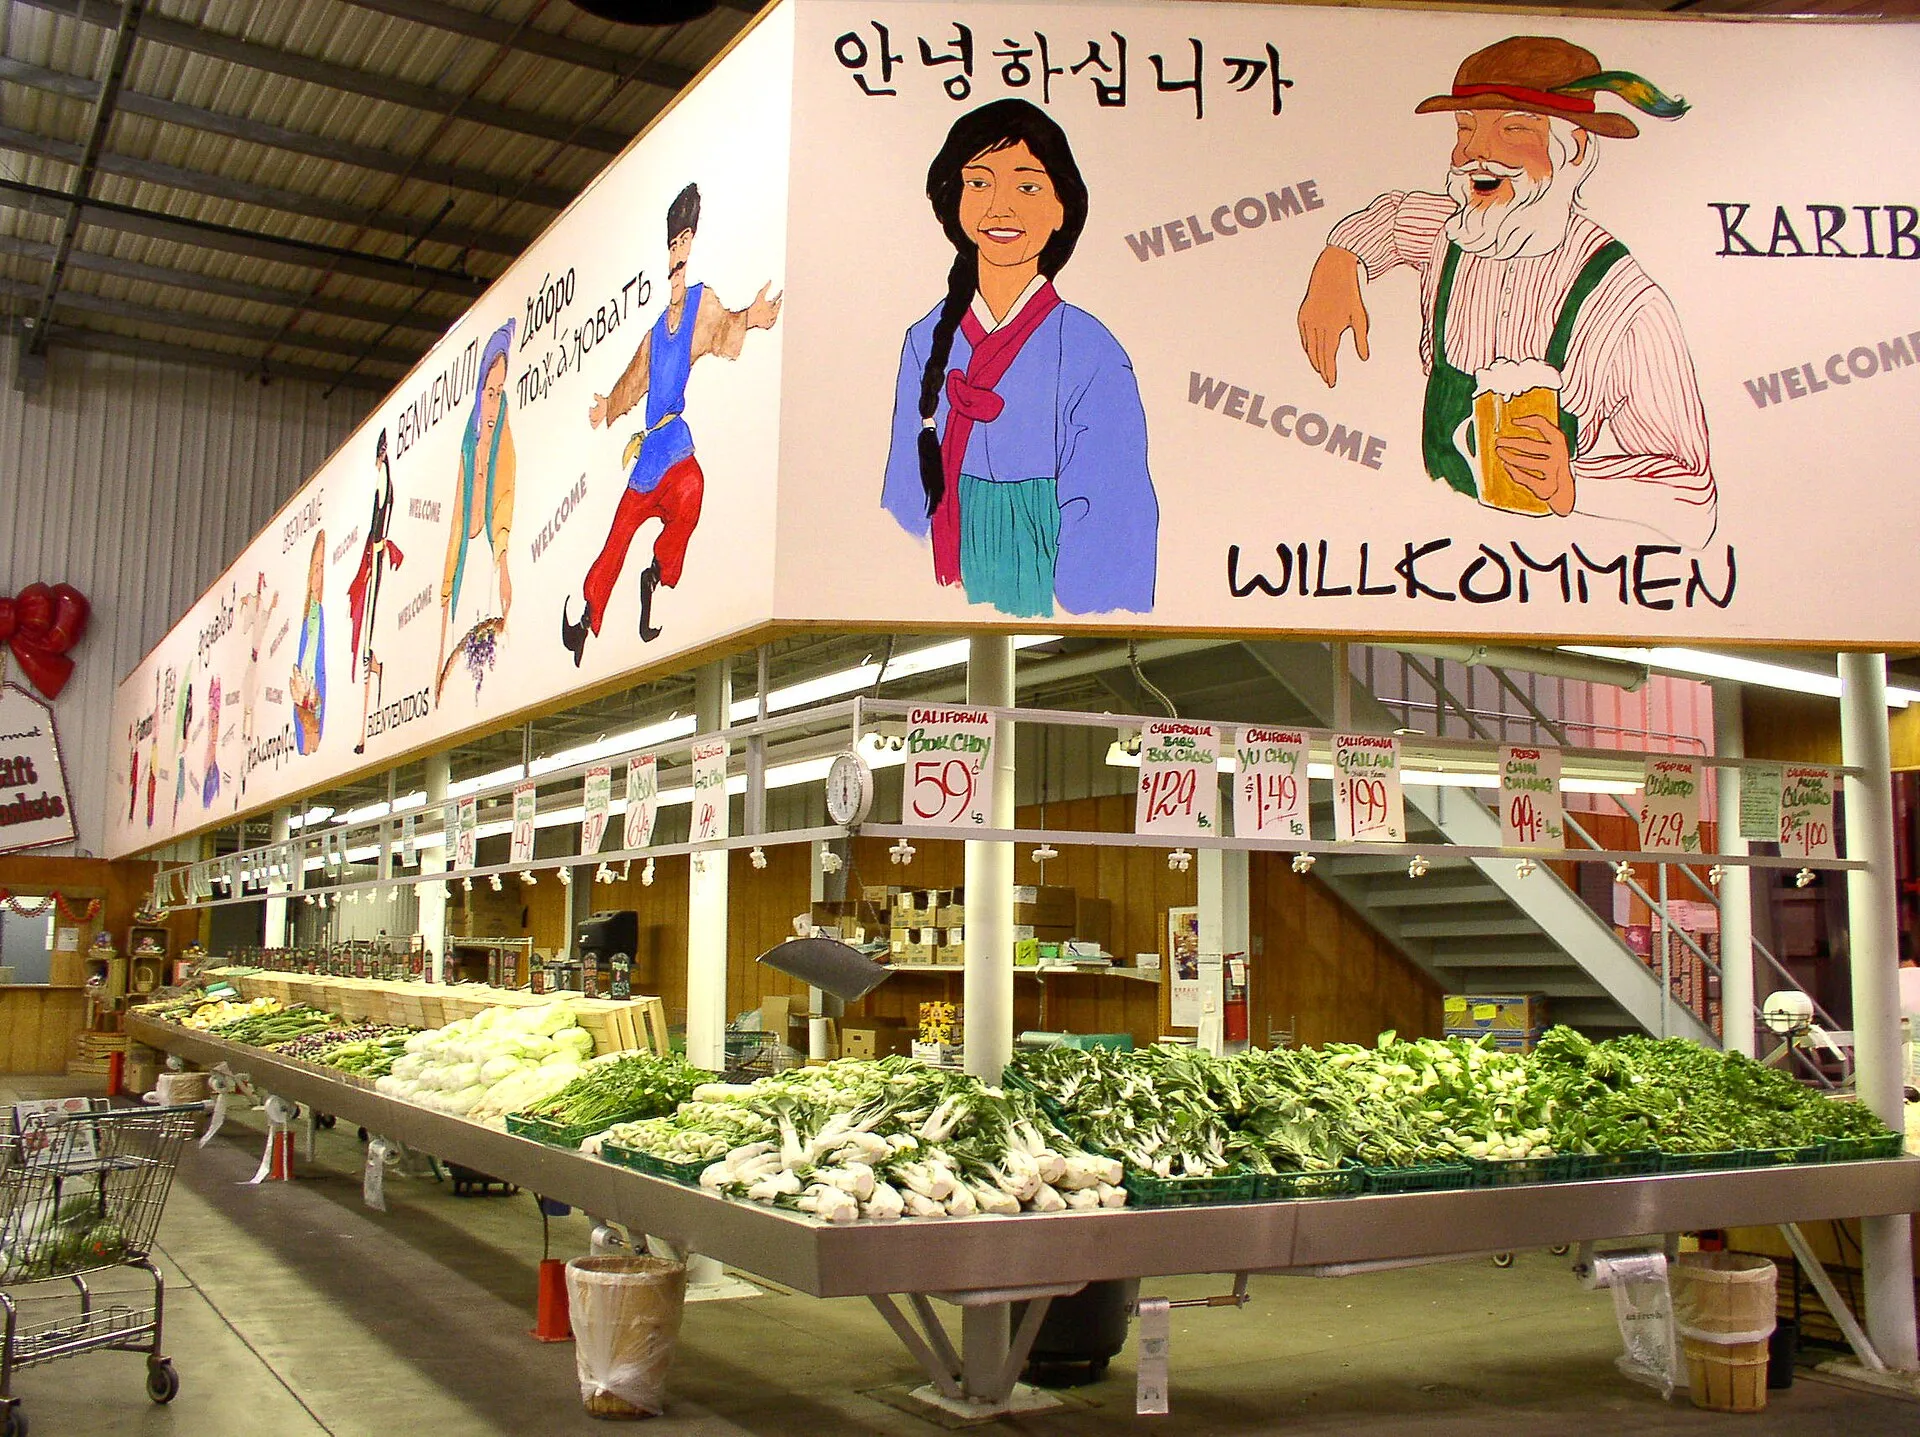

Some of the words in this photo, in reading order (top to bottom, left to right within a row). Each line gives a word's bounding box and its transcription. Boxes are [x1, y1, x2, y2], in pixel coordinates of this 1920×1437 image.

[834, 20, 1294, 120] 안녕하십니까
[1124, 178, 1325, 264] WELCOME
[1707, 202, 1920, 260] KARIB
[396, 336, 479, 460] BENVENUTI
[1187, 371, 1388, 471] WELCOME
[408, 497, 442, 524] WELCOME
[531, 471, 588, 564] WELCOME
[1228, 537, 1737, 610] WILLKOMMEN
[397, 584, 433, 631] WELCOME
[367, 686, 430, 738] BIENVENIDOS
[911, 709, 989, 725] CALIFORNIA
[1150, 722, 1214, 737] CALIFORNIA
[908, 728, 951, 754] BOK
[951, 731, 992, 771] CHOY
[1146, 747, 1173, 763] BOK
[1174, 748, 1214, 764] CHOY
[1163, 735, 1196, 748] BABY
[1246, 728, 1303, 745] CALIFORNIA
[1337, 735, 1393, 749] CALIFORNIA
[1238, 748, 1260, 774] YU
[1265, 747, 1300, 775] CHOY
